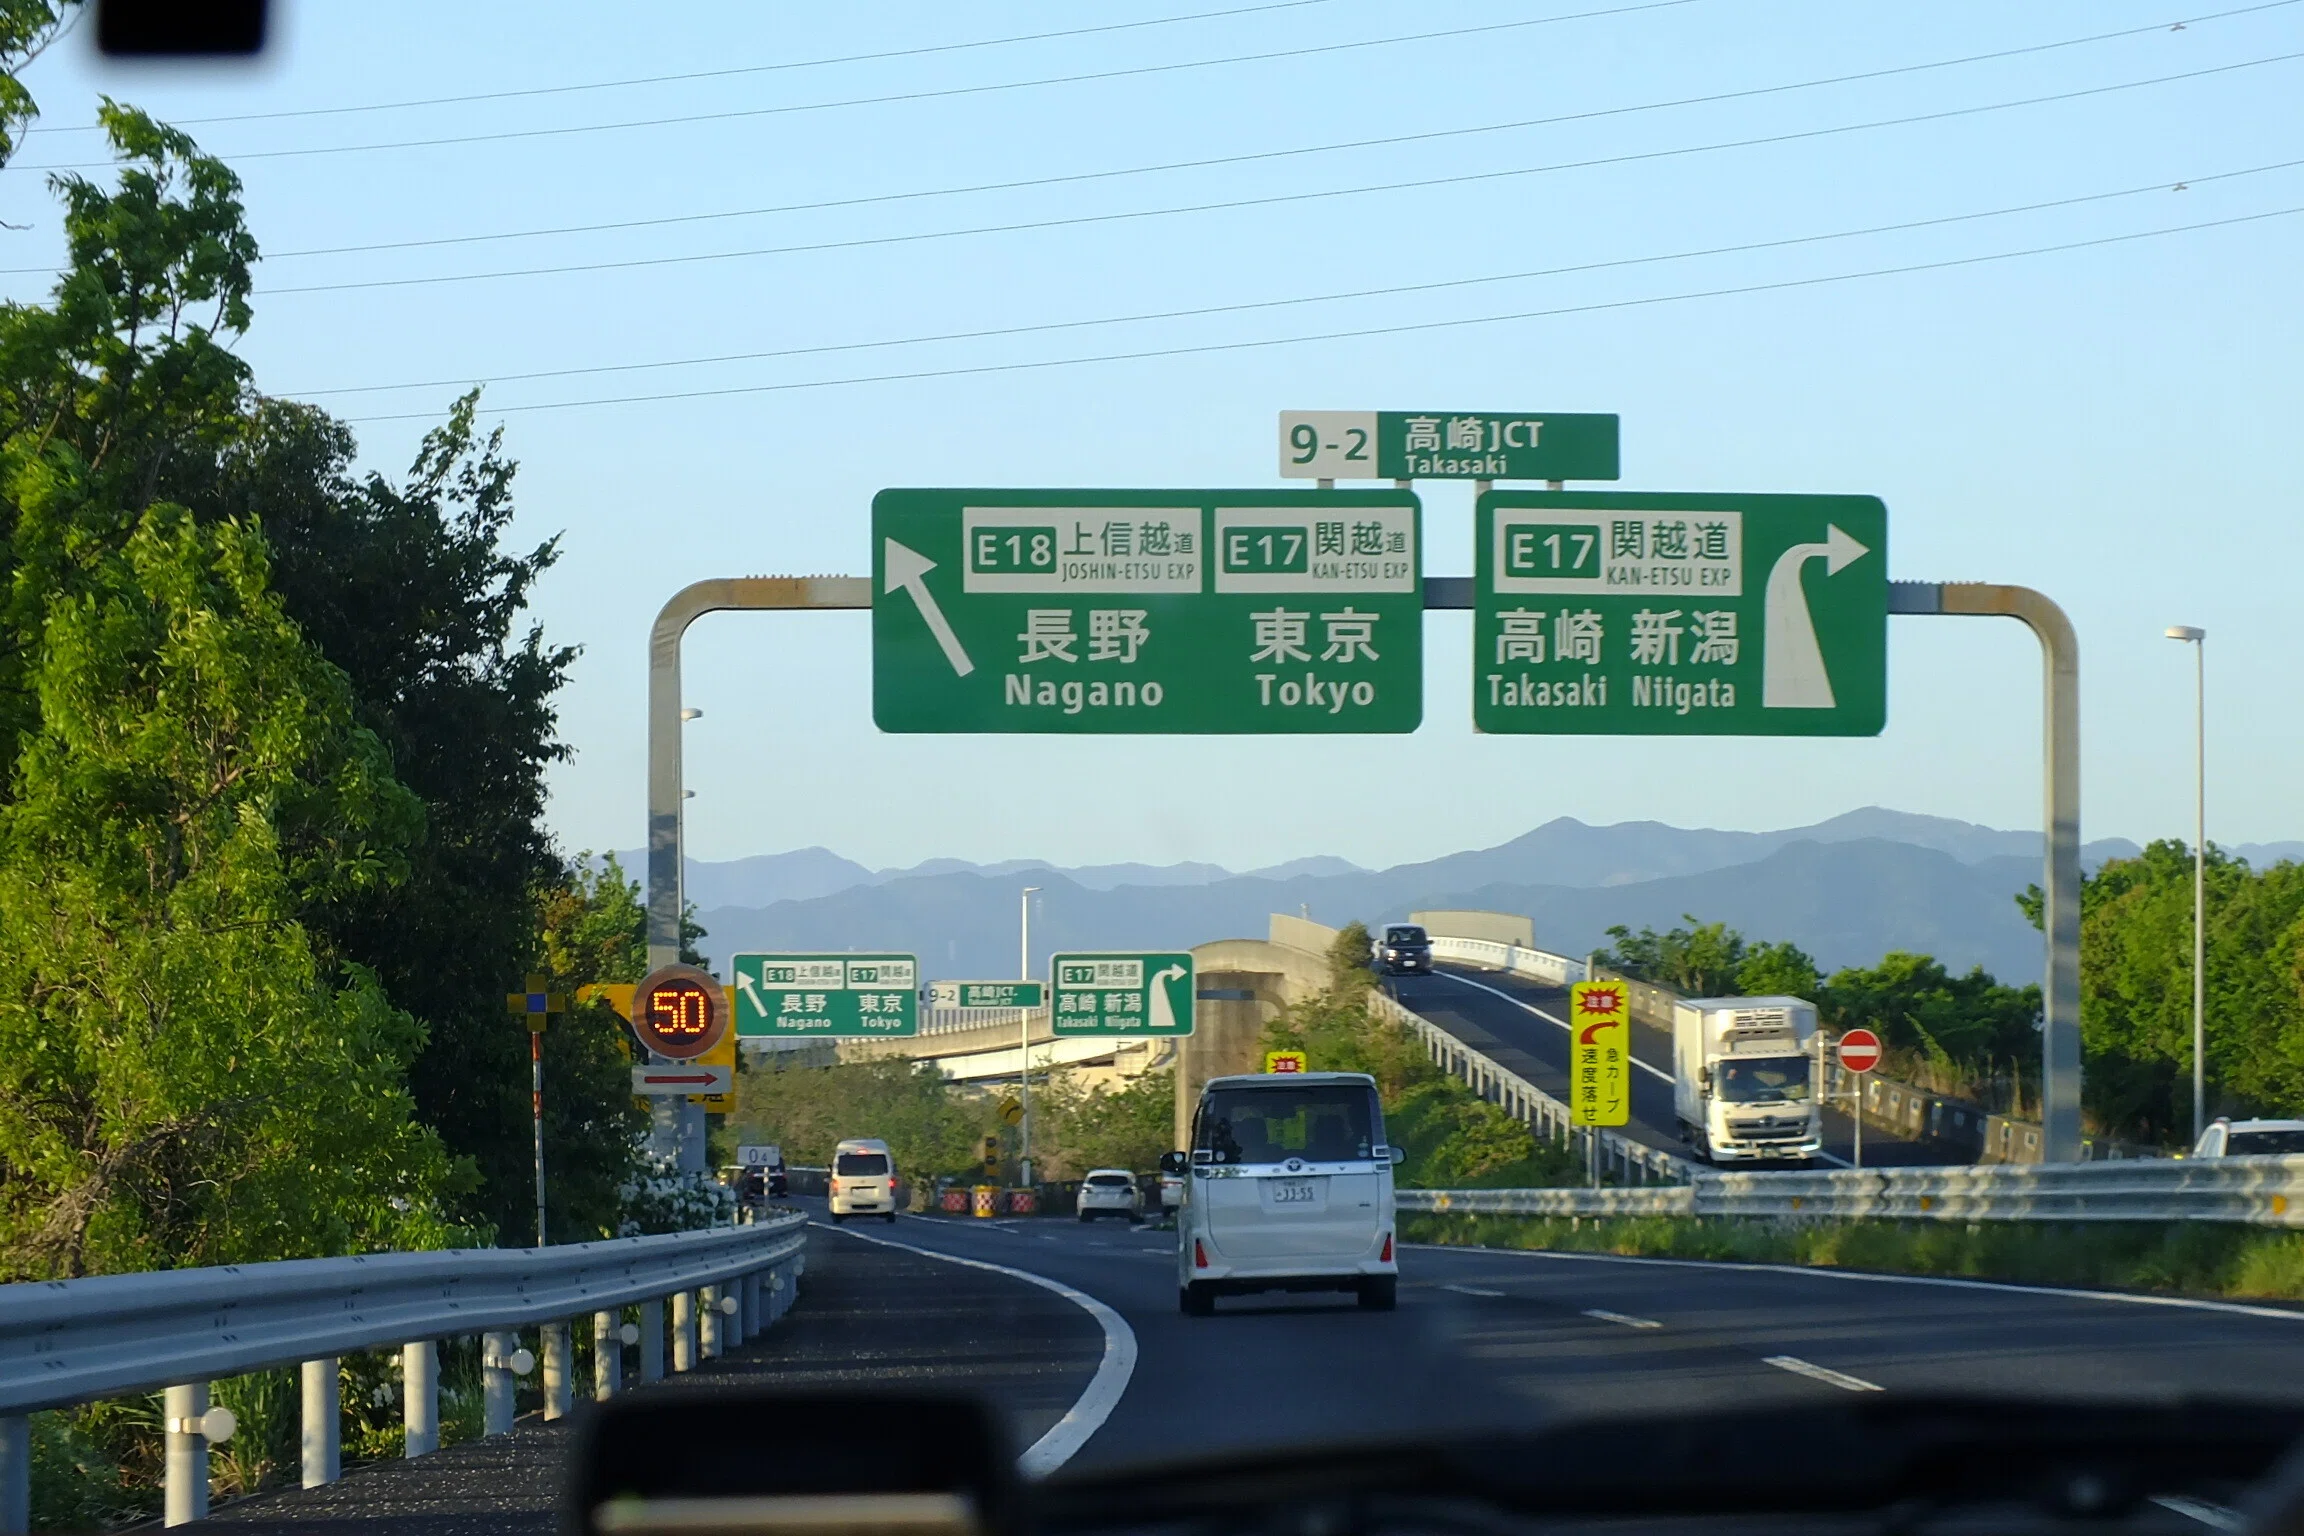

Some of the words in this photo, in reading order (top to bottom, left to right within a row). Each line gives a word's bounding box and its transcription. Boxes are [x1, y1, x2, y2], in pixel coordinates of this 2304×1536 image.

[1290, 424, 1369, 464] 9-2
[1404, 416, 1544, 453] 高崎JCT
[1405, 455, 1508, 475] Takasaki
[978, 534, 1052, 566] E18
[1063, 521, 1195, 557] 上信越道
[1230, 534, 1303, 566] E17
[1315, 521, 1407, 557] 関越道
[1512, 533, 1594, 569] E17
[1610, 520, 1730, 560] 関越道
[1062, 562, 1162, 582] JOSHIN-ETSU
[1168, 562, 1195, 580] EXP
[1313, 562, 1378, 580] KAN-ETSU
[1384, 562, 1408, 580] EXP
[1607, 567, 1692, 586] KAN-ETSU
[1701, 568, 1731, 586] EXP
[1017, 609, 1150, 664] 長野
[1250, 606, 1381, 664] 東京
[1496, 607, 1603, 665] 高崎
[1630, 608, 1739, 666] 新潟
[1005, 674, 1164, 714] Nagano
[1255, 673, 1375, 714] Tokyo
[1488, 673, 1607, 706] Takasaki
[1632, 674, 1736, 714] Niigata
[767, 969, 794, 981] E18
[851, 969, 877, 981] E17
[1064, 968, 1093, 981] E17
[654, 991, 705, 1033] 50
[781, 994, 827, 1013] 長野
[858, 993, 903, 1013] 東京
[928, 989, 955, 1002] 9-2
[776, 1016, 832, 1030] Nagano
[860, 1015, 902, 1031] Tokyo
[1606, 1047, 1620, 1114] 急カーブ
